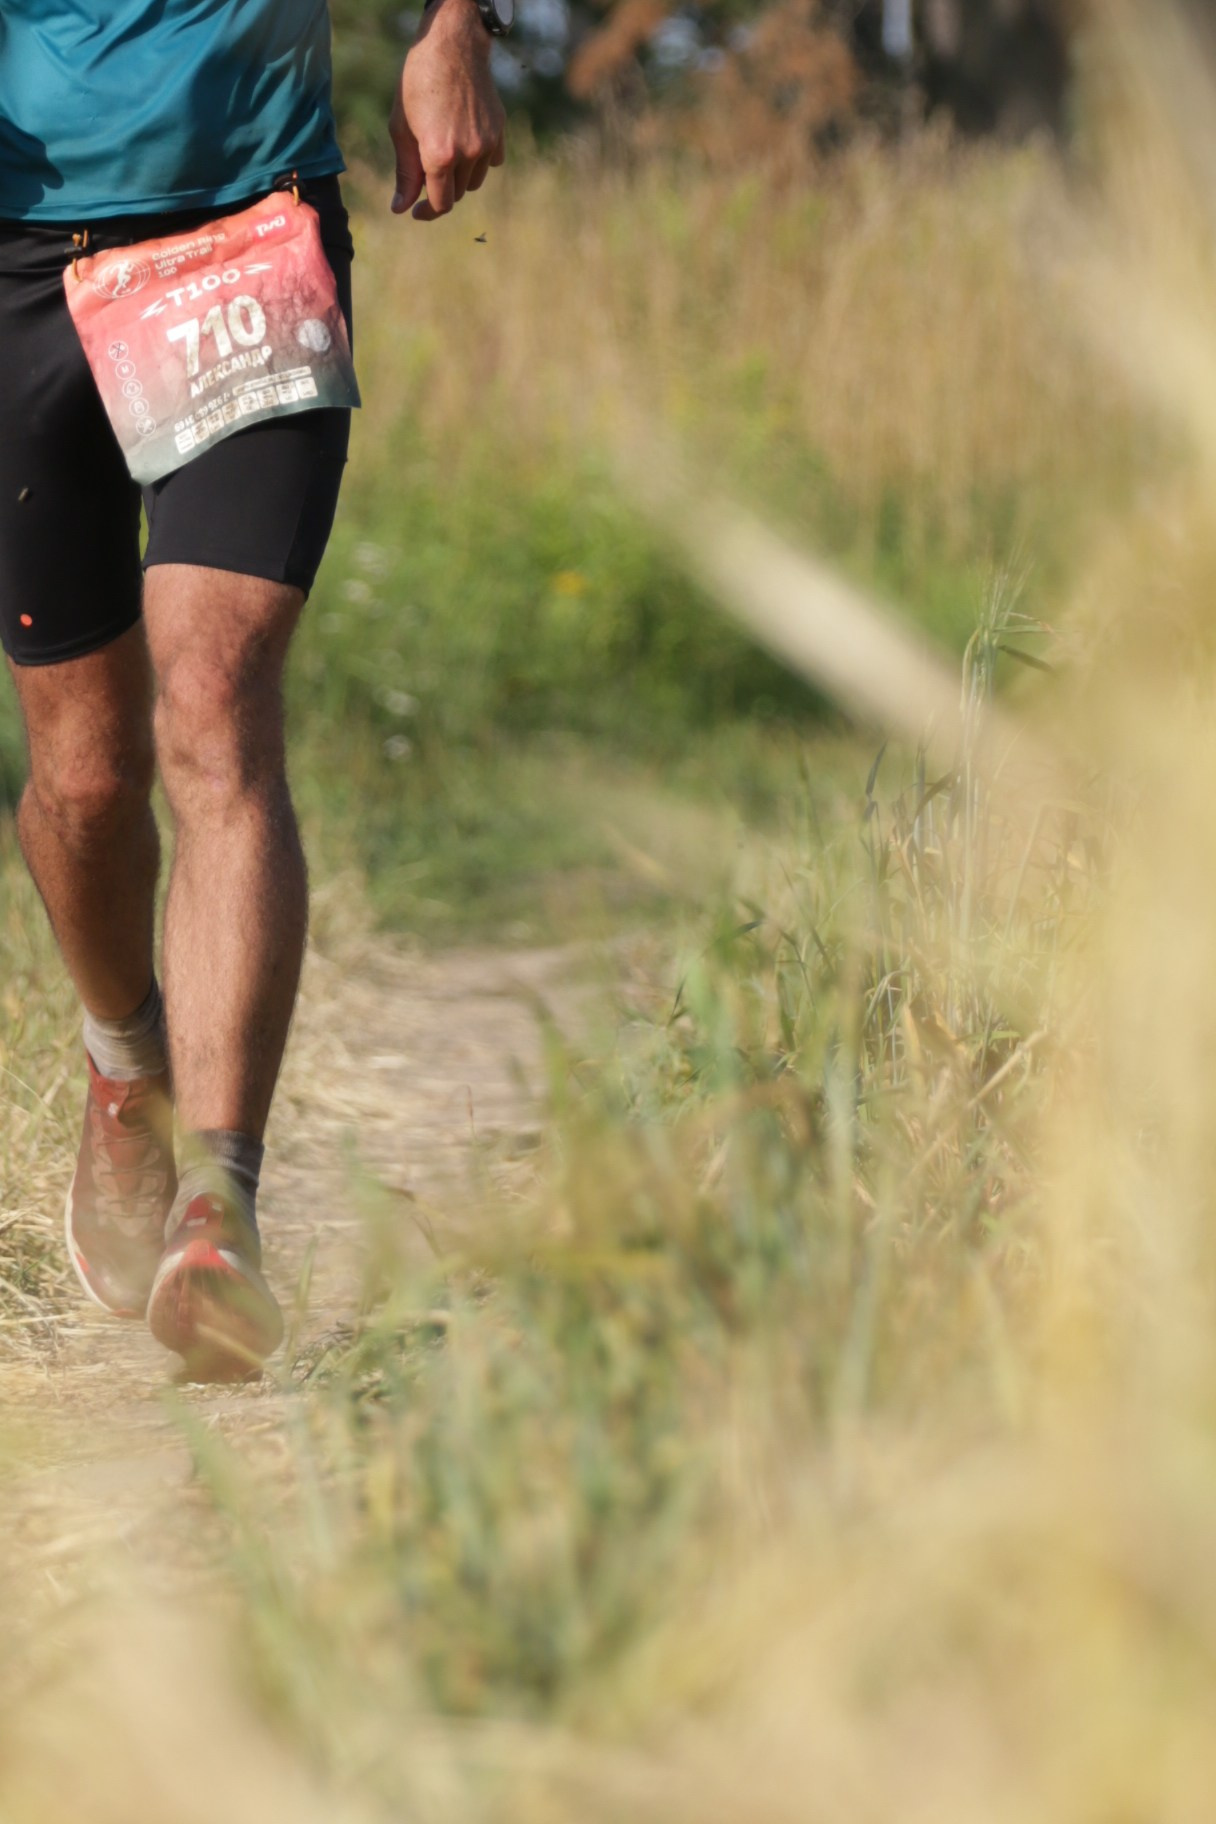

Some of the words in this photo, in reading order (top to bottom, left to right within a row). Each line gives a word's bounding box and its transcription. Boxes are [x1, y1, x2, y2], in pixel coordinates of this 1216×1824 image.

[152, 238, 195, 260] Golden
[197, 232, 226, 246] Ring
[154, 253, 185, 270] Ultra
[186, 243, 213, 259] Trail
[157, 266, 177, 278] 100
[166, 268, 241, 307] T100
[166, 294, 266, 378] 710
[190, 345, 272, 398] АЛЕКСАНДР
